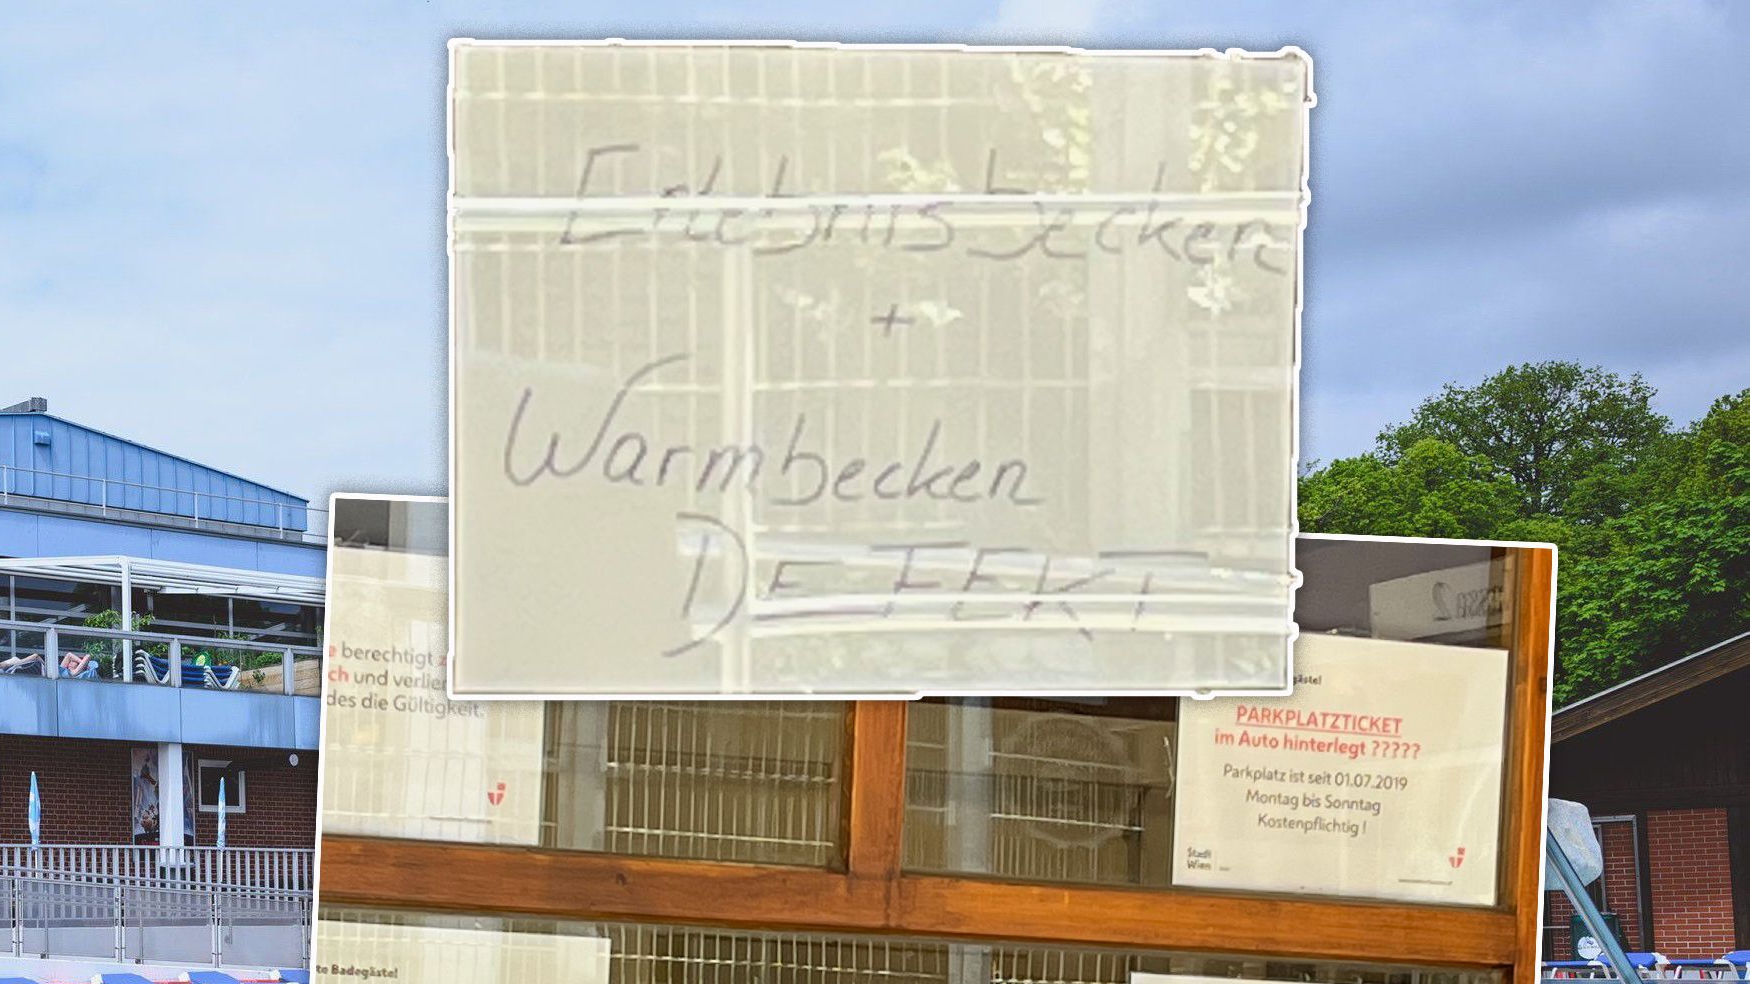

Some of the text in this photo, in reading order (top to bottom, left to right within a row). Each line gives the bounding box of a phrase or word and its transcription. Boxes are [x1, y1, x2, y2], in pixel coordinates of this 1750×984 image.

[873, 304, 914, 337] +
[504, 354, 1045, 509] Warmbecken
[663, 514, 1209, 657] DEFEKT
[342, 641, 434, 669] berechtigt
[354, 670, 388, 686] und
[362, 693, 389, 711] die
[393, 694, 485, 720] Gültigkeit.
[1236, 705, 1403, 735] PARKPLATZTICKET
[1214, 728, 1421, 760] im Auto hinterlegt ?????
[1223, 764, 1408, 791] Parkplatz ist seit 01.07.2019
[1246, 790, 1381, 817] Montag bis Sonntag
[1258, 814, 1359, 838] Kostenpflichtig
[331, 964, 398, 980] Badegäste!
